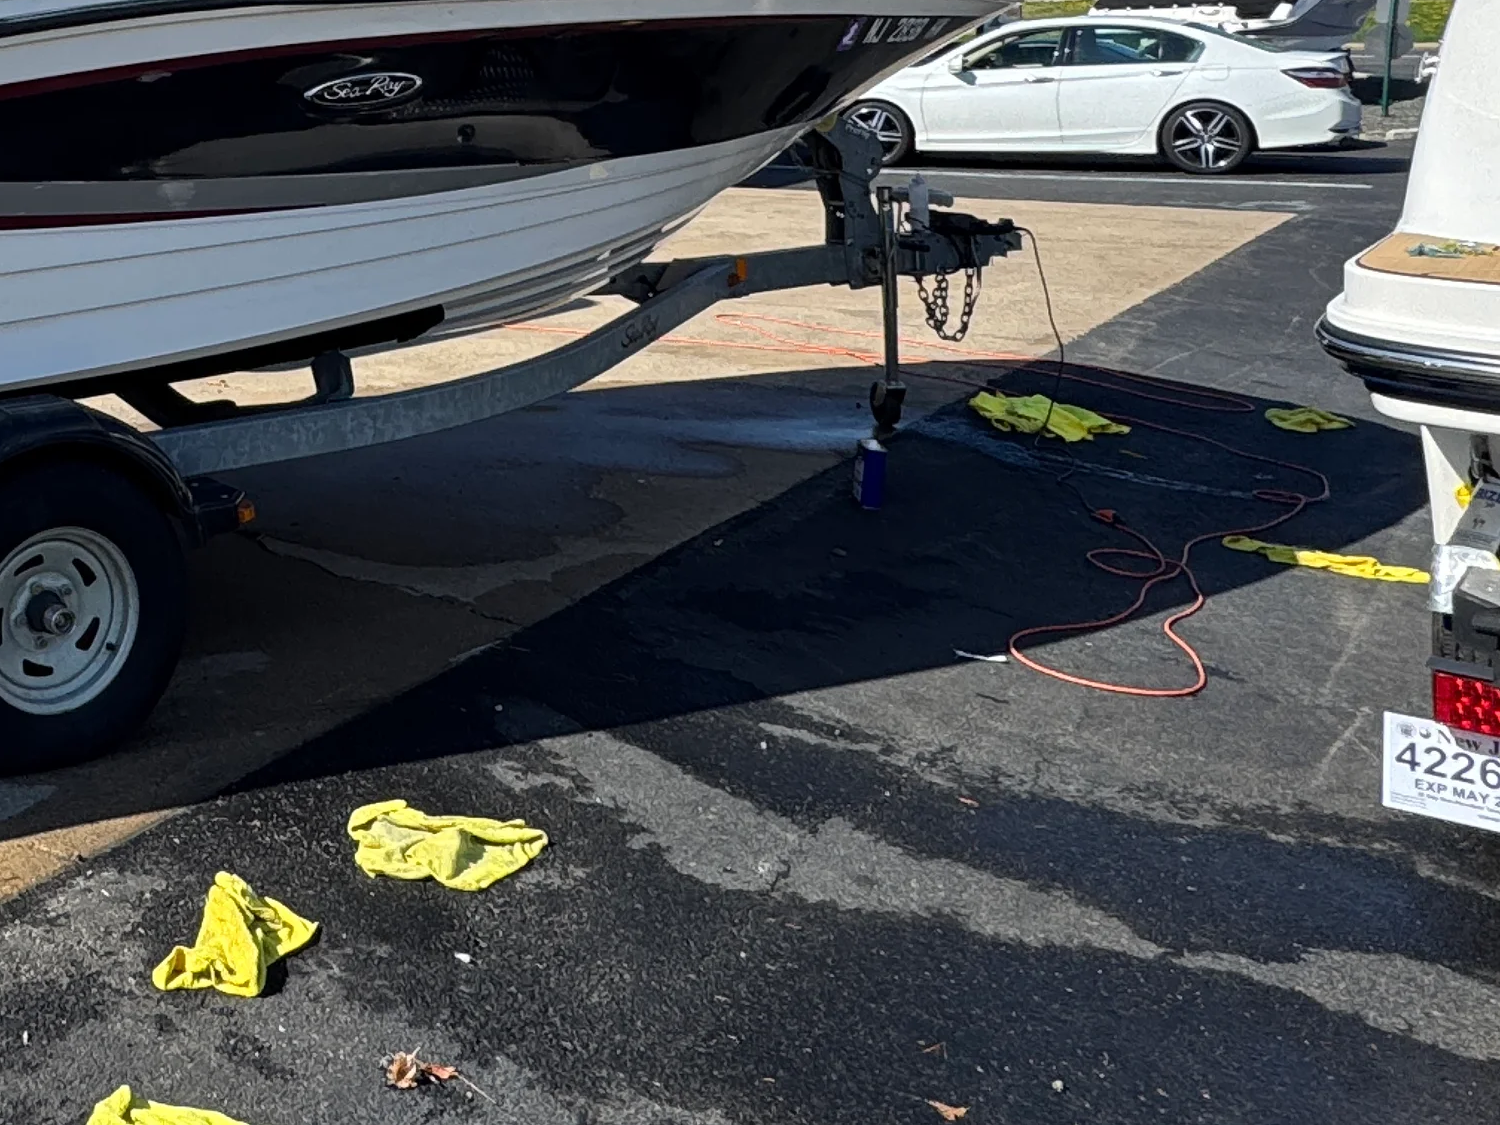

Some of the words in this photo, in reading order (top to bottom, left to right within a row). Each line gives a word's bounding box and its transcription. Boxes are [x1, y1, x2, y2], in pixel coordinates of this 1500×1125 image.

[323, 81, 361, 100] Sea
[365, 74, 407, 97] Ray
[1436, 728, 1481, 752] New
[1395, 742, 1500, 790] 4226
[1414, 778, 1448, 795] EXP
[1452, 786, 1490, 805] MAY
